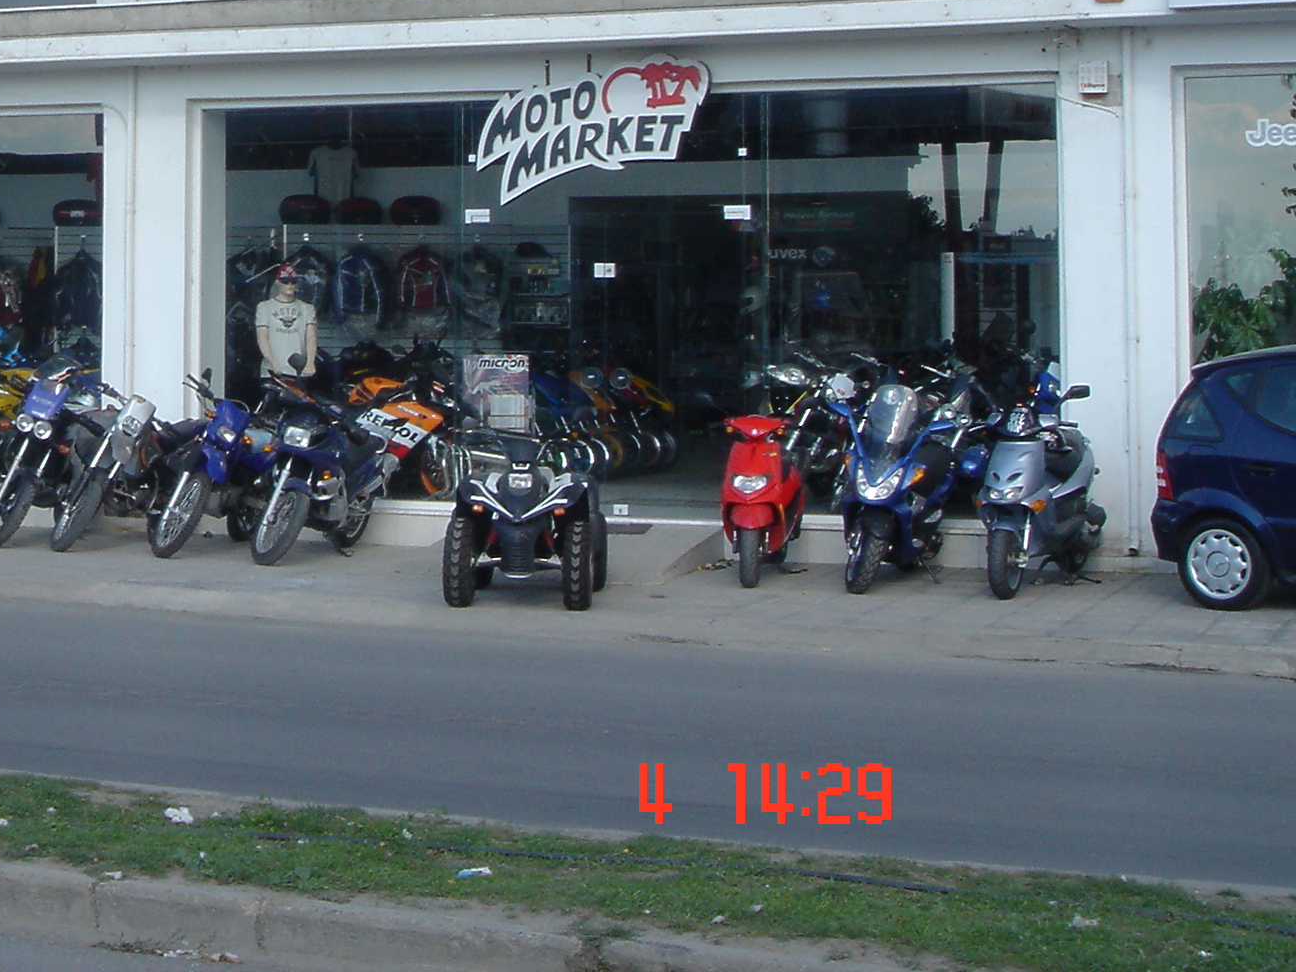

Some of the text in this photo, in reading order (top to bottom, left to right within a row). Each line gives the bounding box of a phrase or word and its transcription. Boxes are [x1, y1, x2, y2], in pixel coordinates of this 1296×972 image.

[482, 80, 597, 159] MOTO
[506, 114, 685, 193] MARKET
[478, 359, 526, 372] micron
[361, 410, 420, 443] REOL
